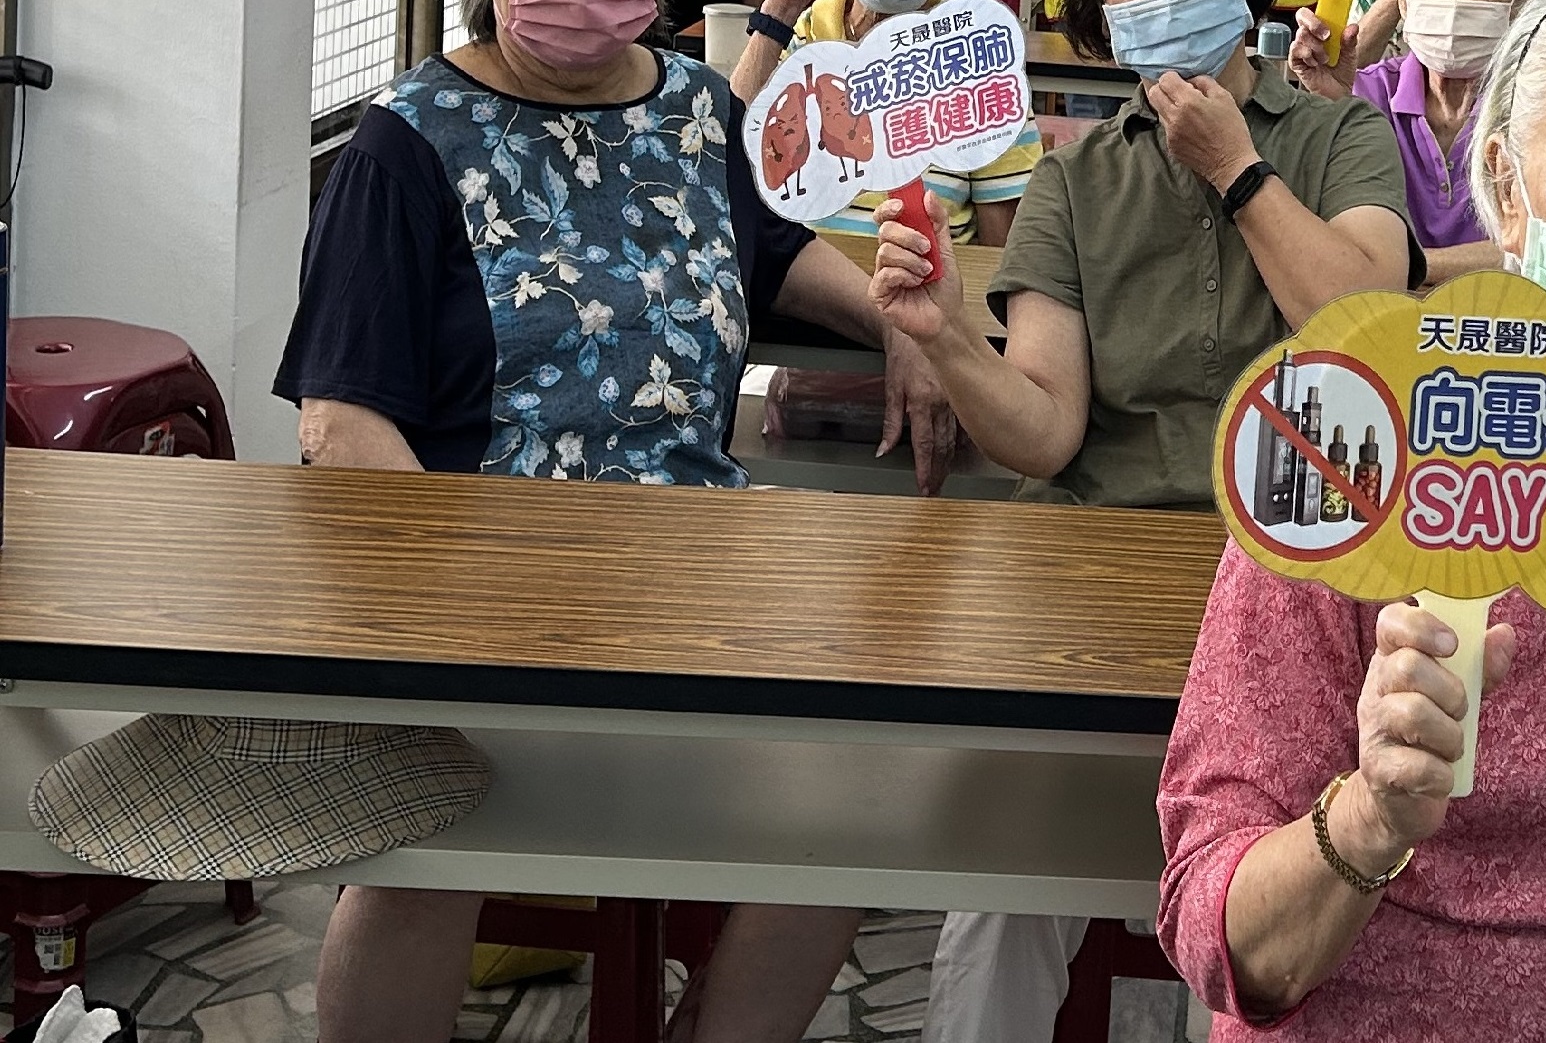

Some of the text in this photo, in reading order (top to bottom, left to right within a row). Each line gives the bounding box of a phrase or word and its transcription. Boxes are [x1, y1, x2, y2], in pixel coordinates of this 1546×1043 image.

[850, 26, 1013, 114] 戒菸保肺
[890, 11, 974, 52] 天晟醫院
[885, 75, 1022, 157] 護健康
